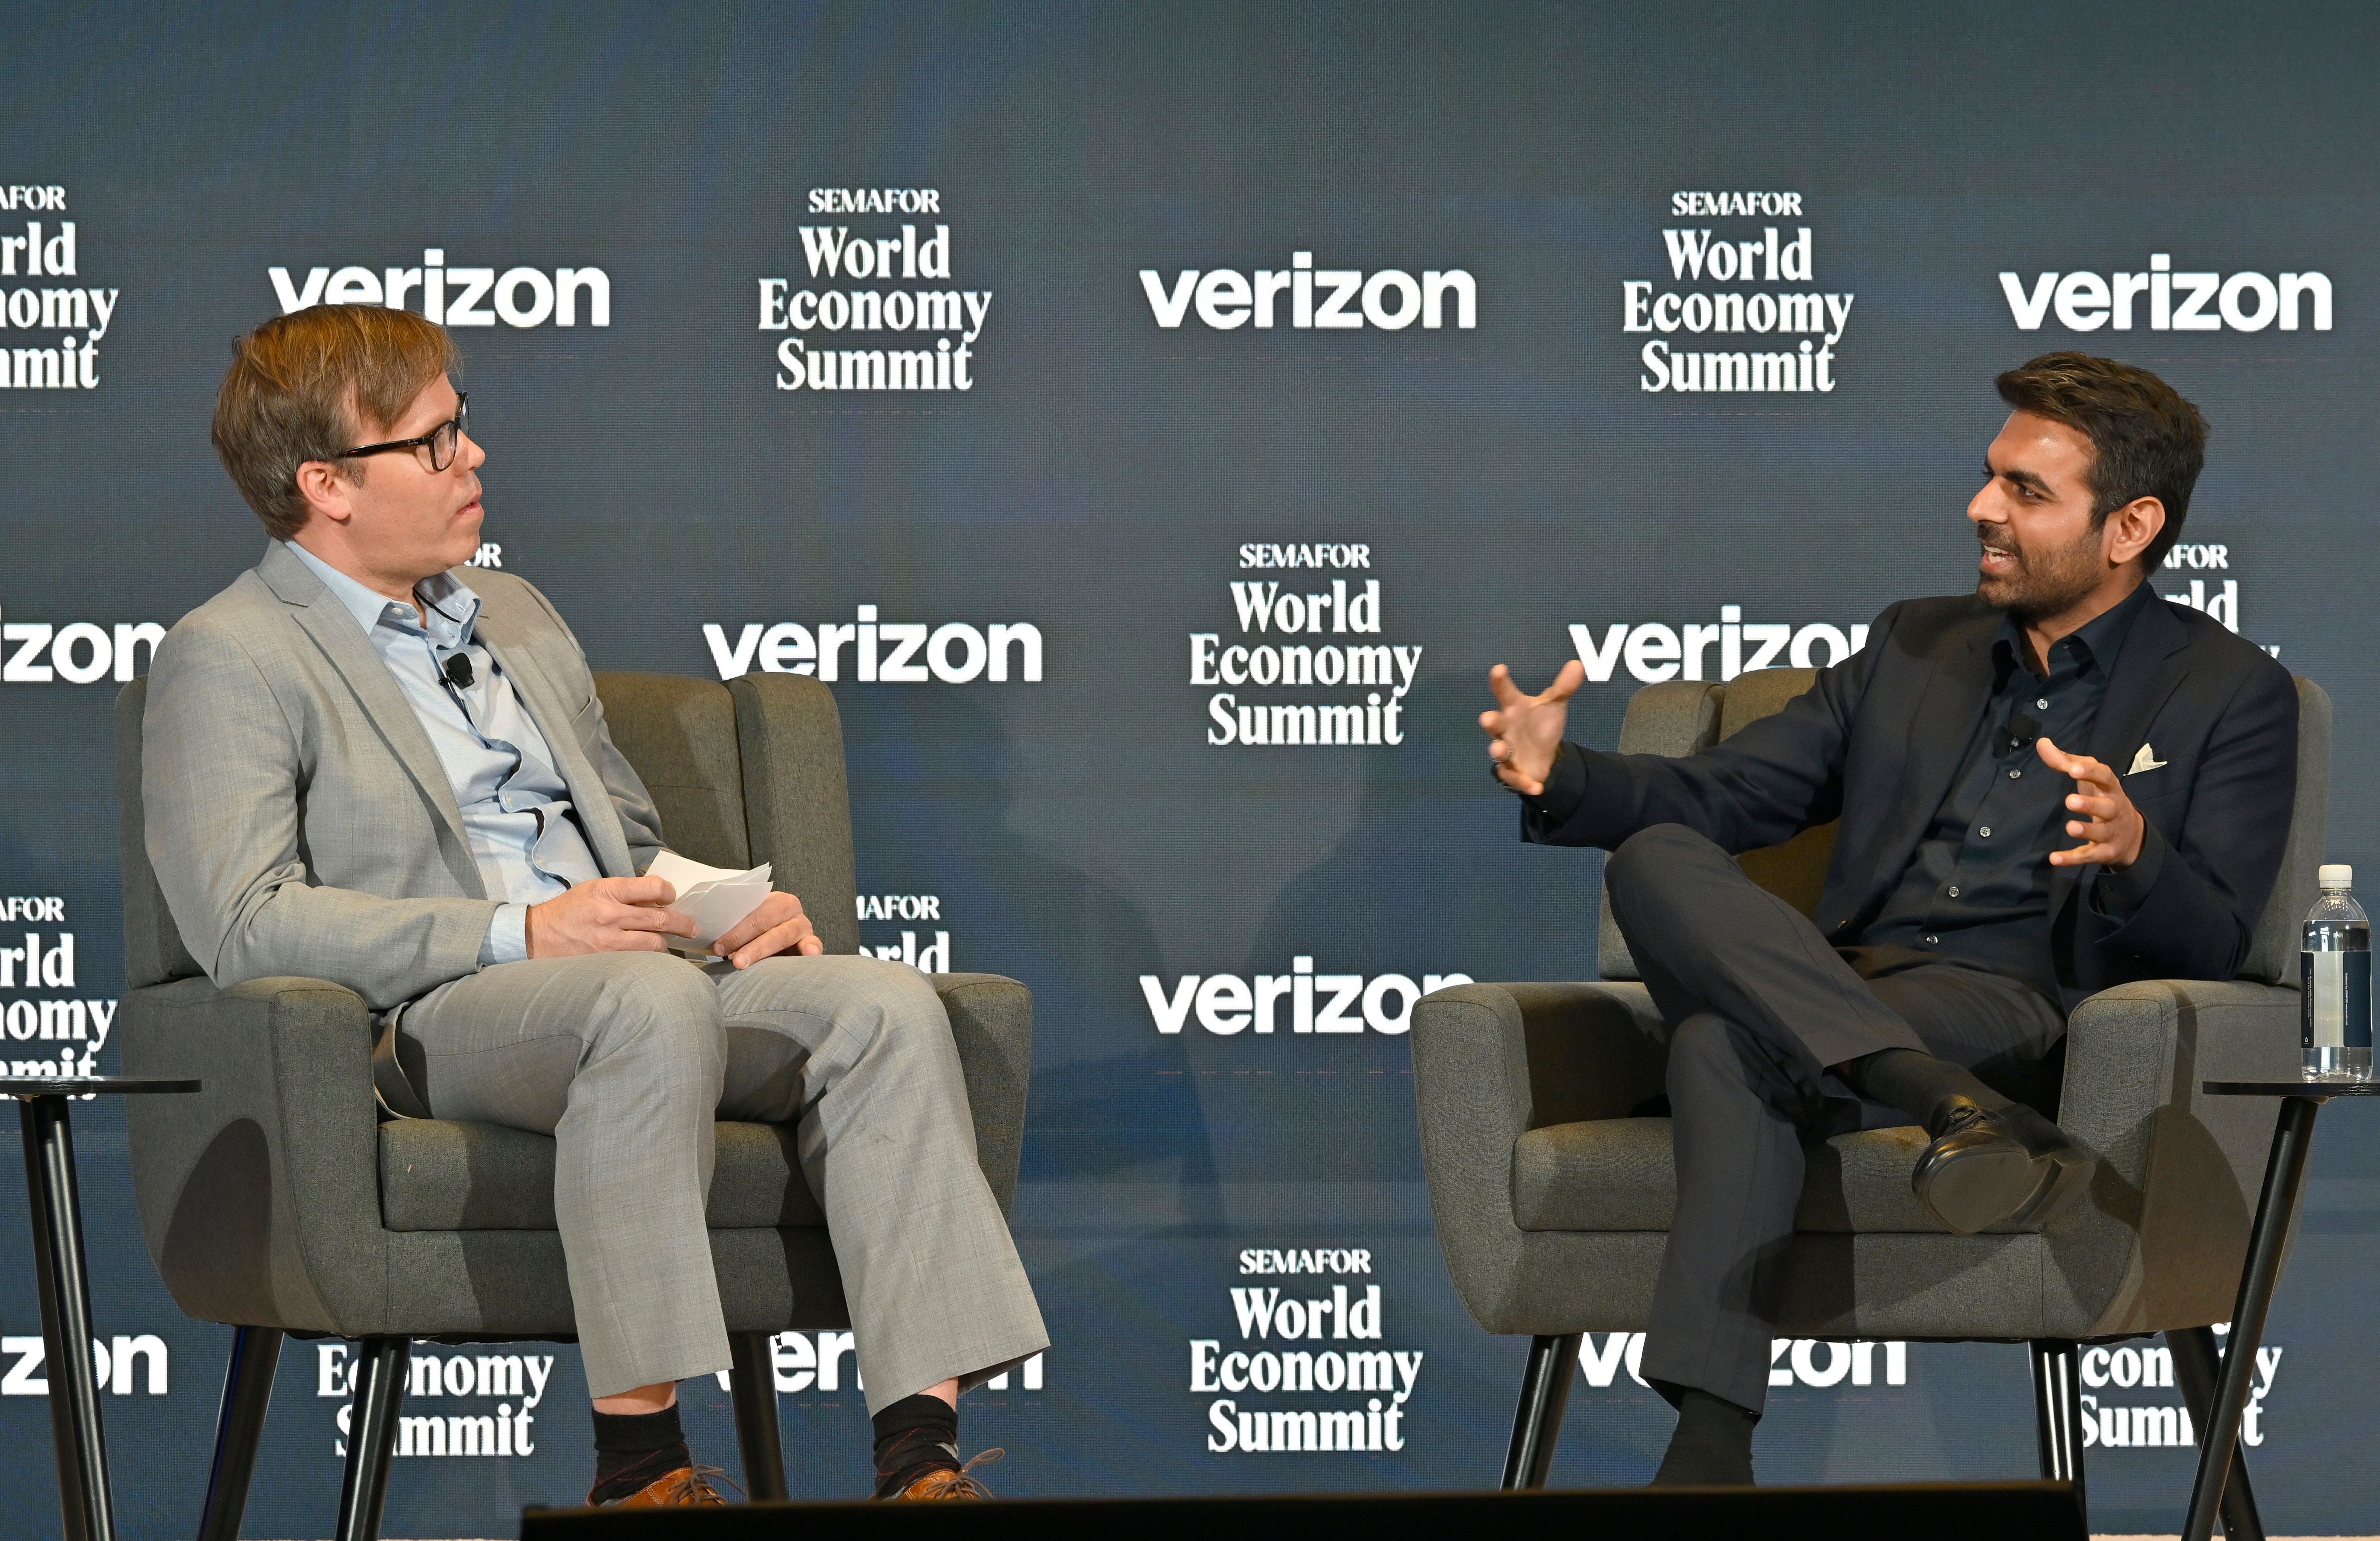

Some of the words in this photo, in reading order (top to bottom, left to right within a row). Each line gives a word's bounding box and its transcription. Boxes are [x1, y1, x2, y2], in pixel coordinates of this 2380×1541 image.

[0, 186, 66, 212] AFOR
[809, 188, 940, 214] SEMAFOR
[1672, 192, 1802, 216] SEMAFOR
[0, 222, 77, 276] rld
[799, 225, 950, 278] World
[1663, 227, 1812, 280] World
[268, 249, 610, 328] verizon
[758, 278, 992, 342] Economy
[1139, 252, 1477, 330] verizon
[1623, 281, 1854, 345] Economy
[1998, 254, 2332, 332] verizon
[0, 335, 100, 389] mit
[777, 338, 973, 390] Summit
[1641, 340, 1835, 393] Summit
[1239, 544, 1371, 568] SEMAFOR
[1230, 579, 1381, 633] World
[703, 604, 1042, 684] verizon
[1190, 633, 1423, 696] Economy
[1568, 605, 1869, 684] verizo
[1208, 692, 1404, 745] Summit
[856, 896, 940, 920] AFOR
[0, 932, 75, 988] rld
[859, 931, 950, 974] rld
[1139, 956, 1475, 1035] verizo
[1240, 1249, 1372, 1274] SEMAFOR
[1230, 1284, 1381, 1340] World
[316, 1343, 555, 1408] Enomy
[1190, 1339, 1424, 1401] Economy
[2078, 1345, 2283, 1399] cony
[1208, 1398, 1405, 1452] Summit
[2081, 1394, 2264, 1448] Sumt
